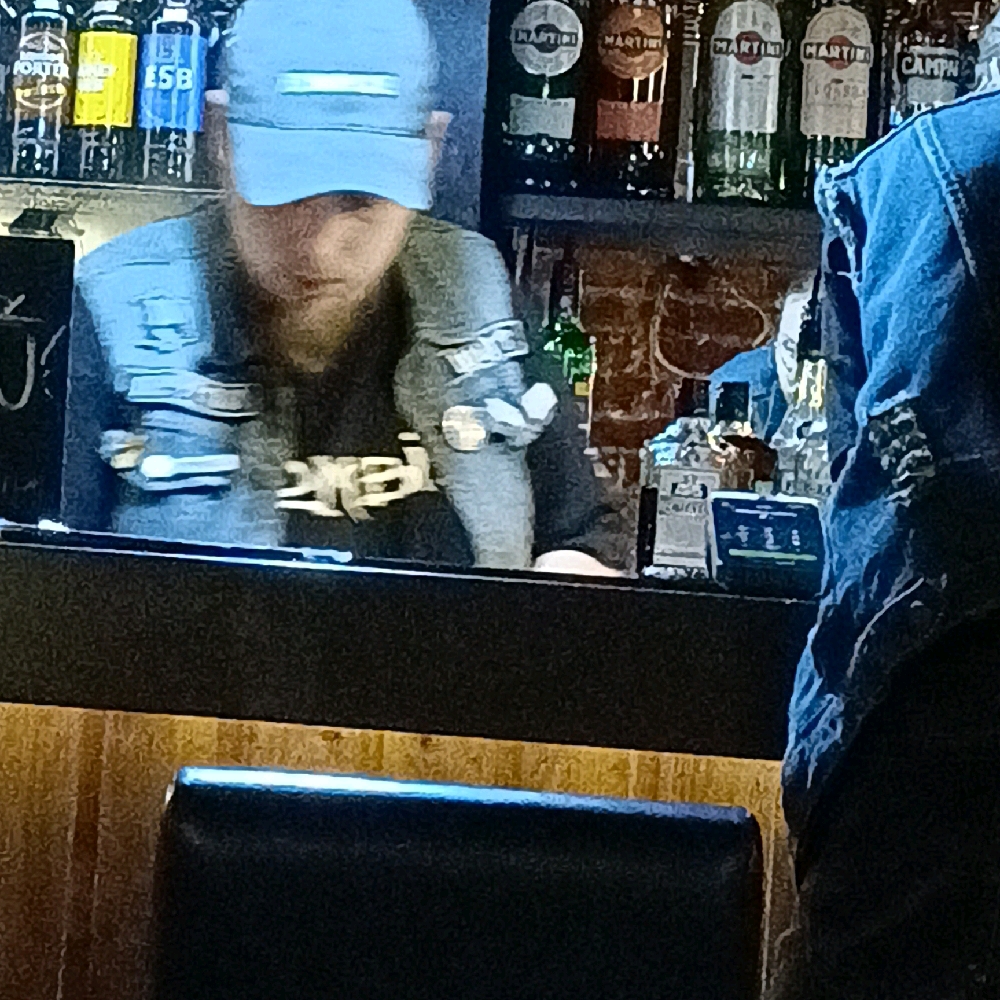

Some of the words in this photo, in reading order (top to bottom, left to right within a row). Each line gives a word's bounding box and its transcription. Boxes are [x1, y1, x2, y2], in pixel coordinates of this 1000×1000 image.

[516, 28, 578, 48] MARTINI
[603, 33, 663, 50] MARTINI
[714, 39, 782, 59] MARTINI
[804, 43, 871, 64] MARTINI
[143, 63, 194, 91] ESB
